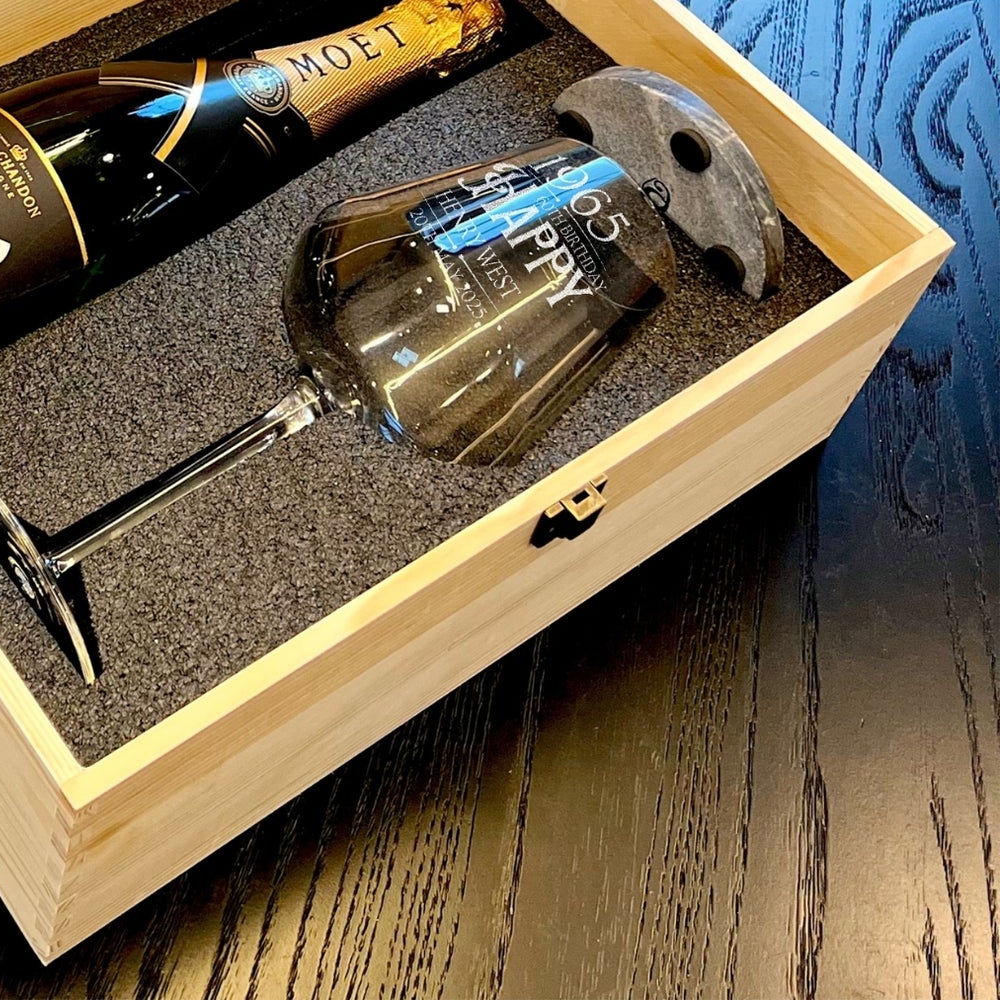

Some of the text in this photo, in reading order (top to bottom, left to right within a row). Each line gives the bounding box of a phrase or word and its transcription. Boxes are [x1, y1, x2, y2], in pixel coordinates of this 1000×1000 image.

[457, 162, 594, 307] HAPPY
[535, 155, 631, 242] 1965
[435, 189, 521, 298] HENRY WEST
[559, 223, 607, 292] BIRTHDAY
[456, 282, 488, 319] 2025
